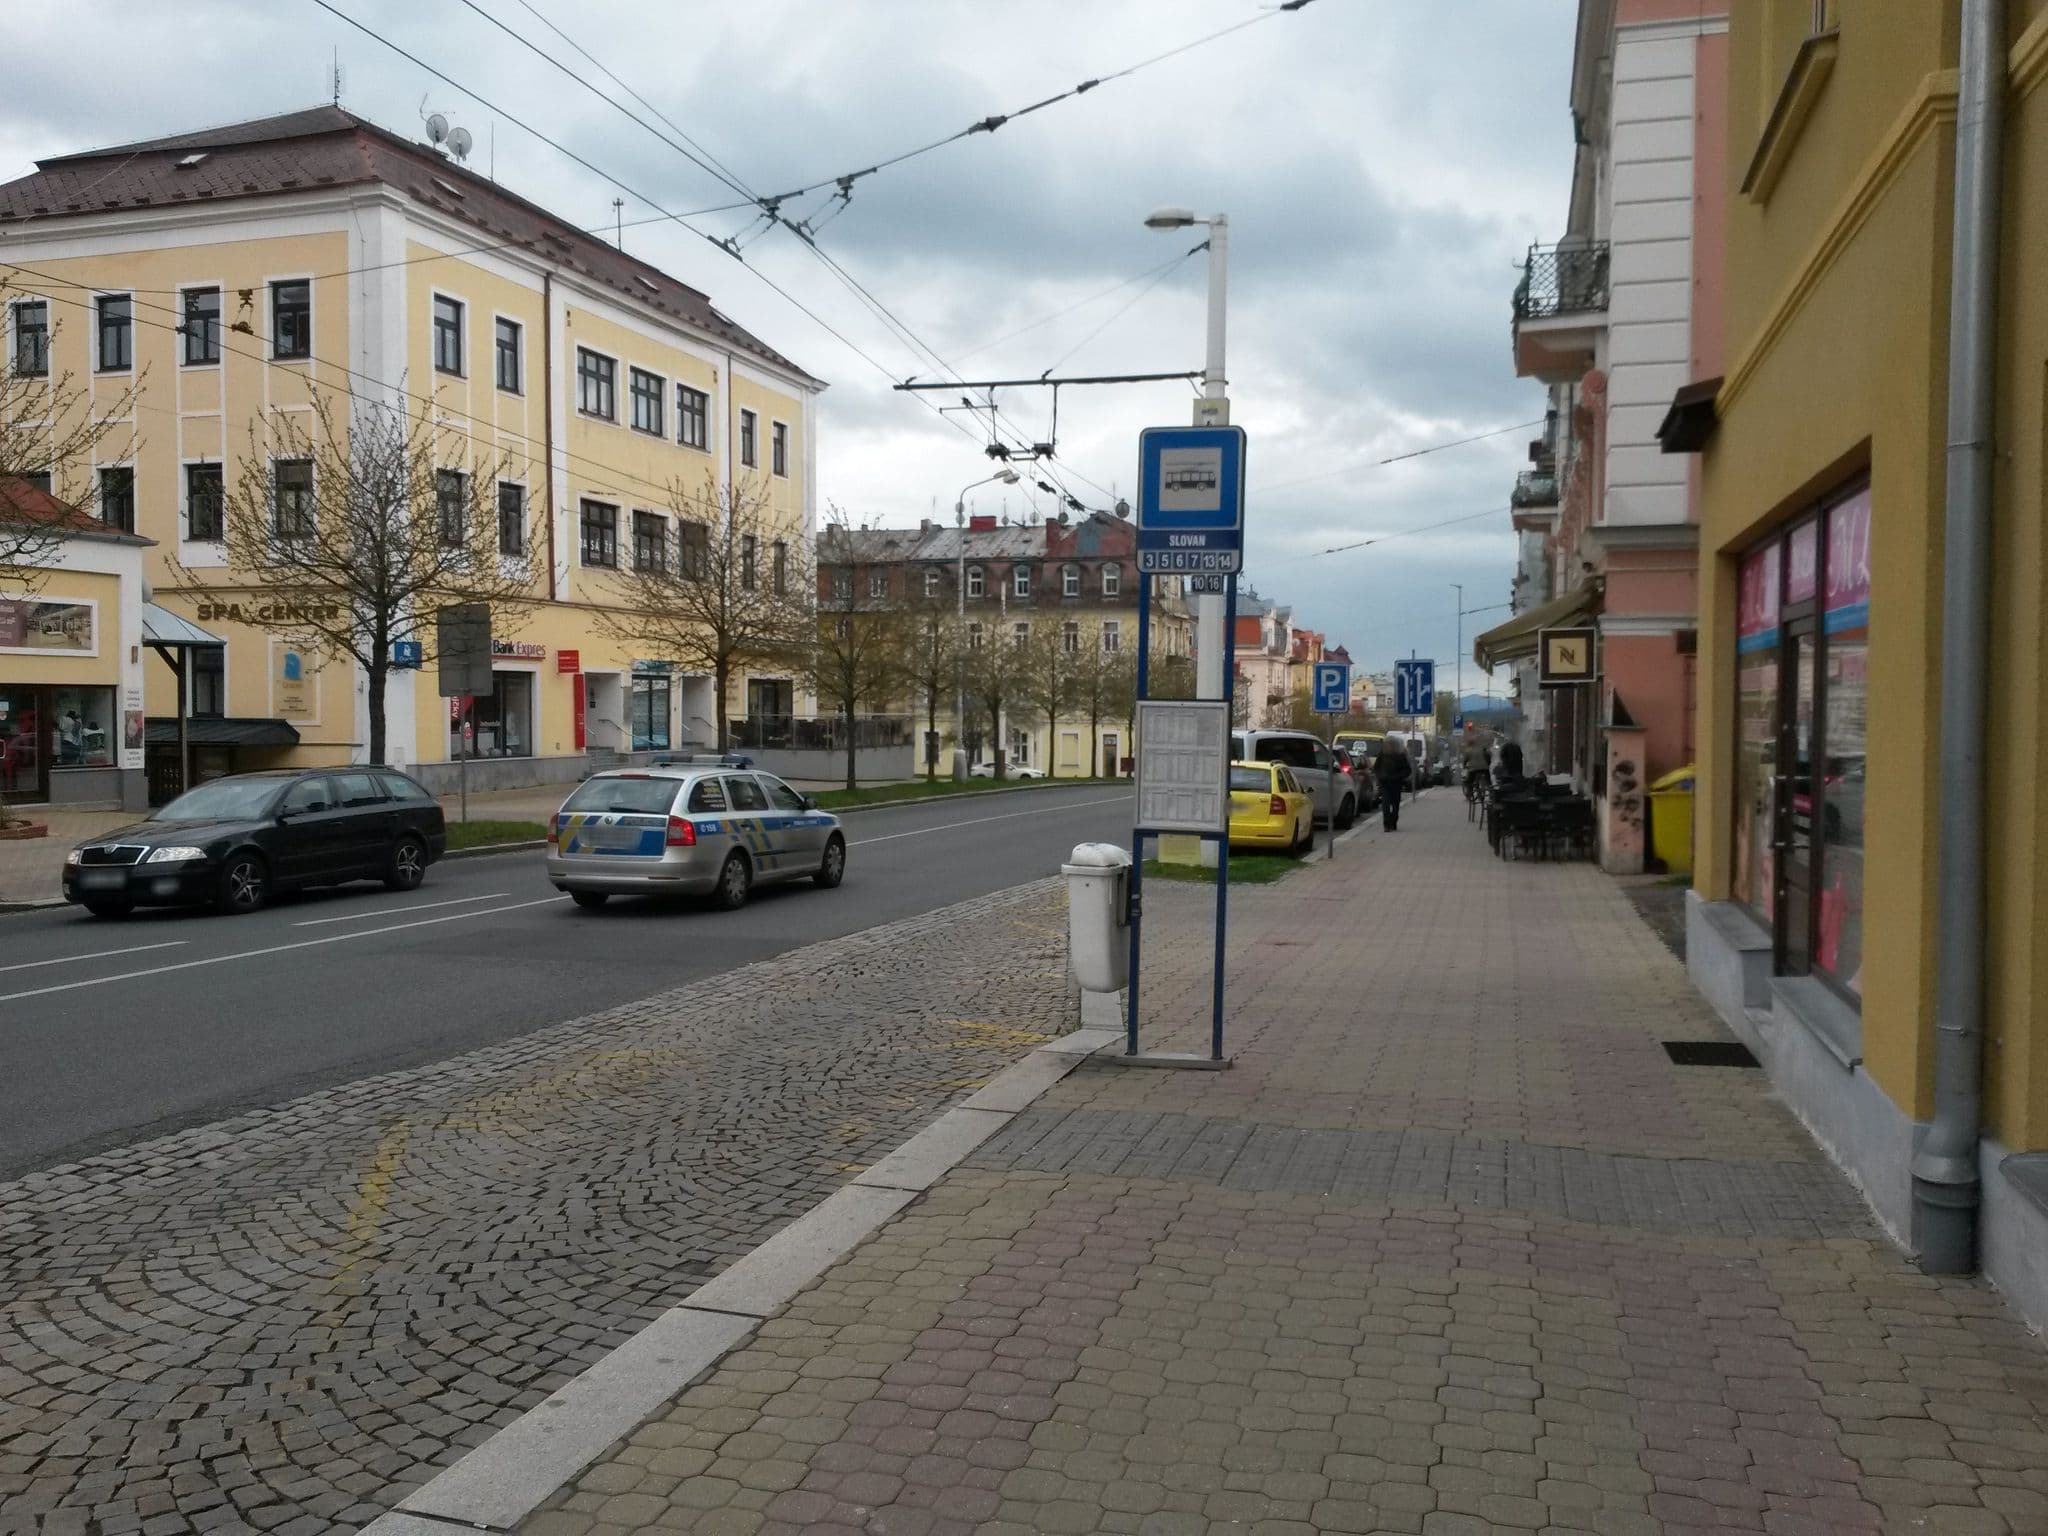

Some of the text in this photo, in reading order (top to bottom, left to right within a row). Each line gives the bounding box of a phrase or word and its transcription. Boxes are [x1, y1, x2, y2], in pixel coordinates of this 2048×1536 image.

[1169, 535, 1206, 547] SLOVAN
[1146, 554, 1231, 568] 3 5 6 7 13 14
[1193, 576, 1204, 589] 10
[198, 604, 340, 621] SPA CENTER
[493, 640, 546, 656] Bank Expres
[1321, 669, 1341, 697] P
